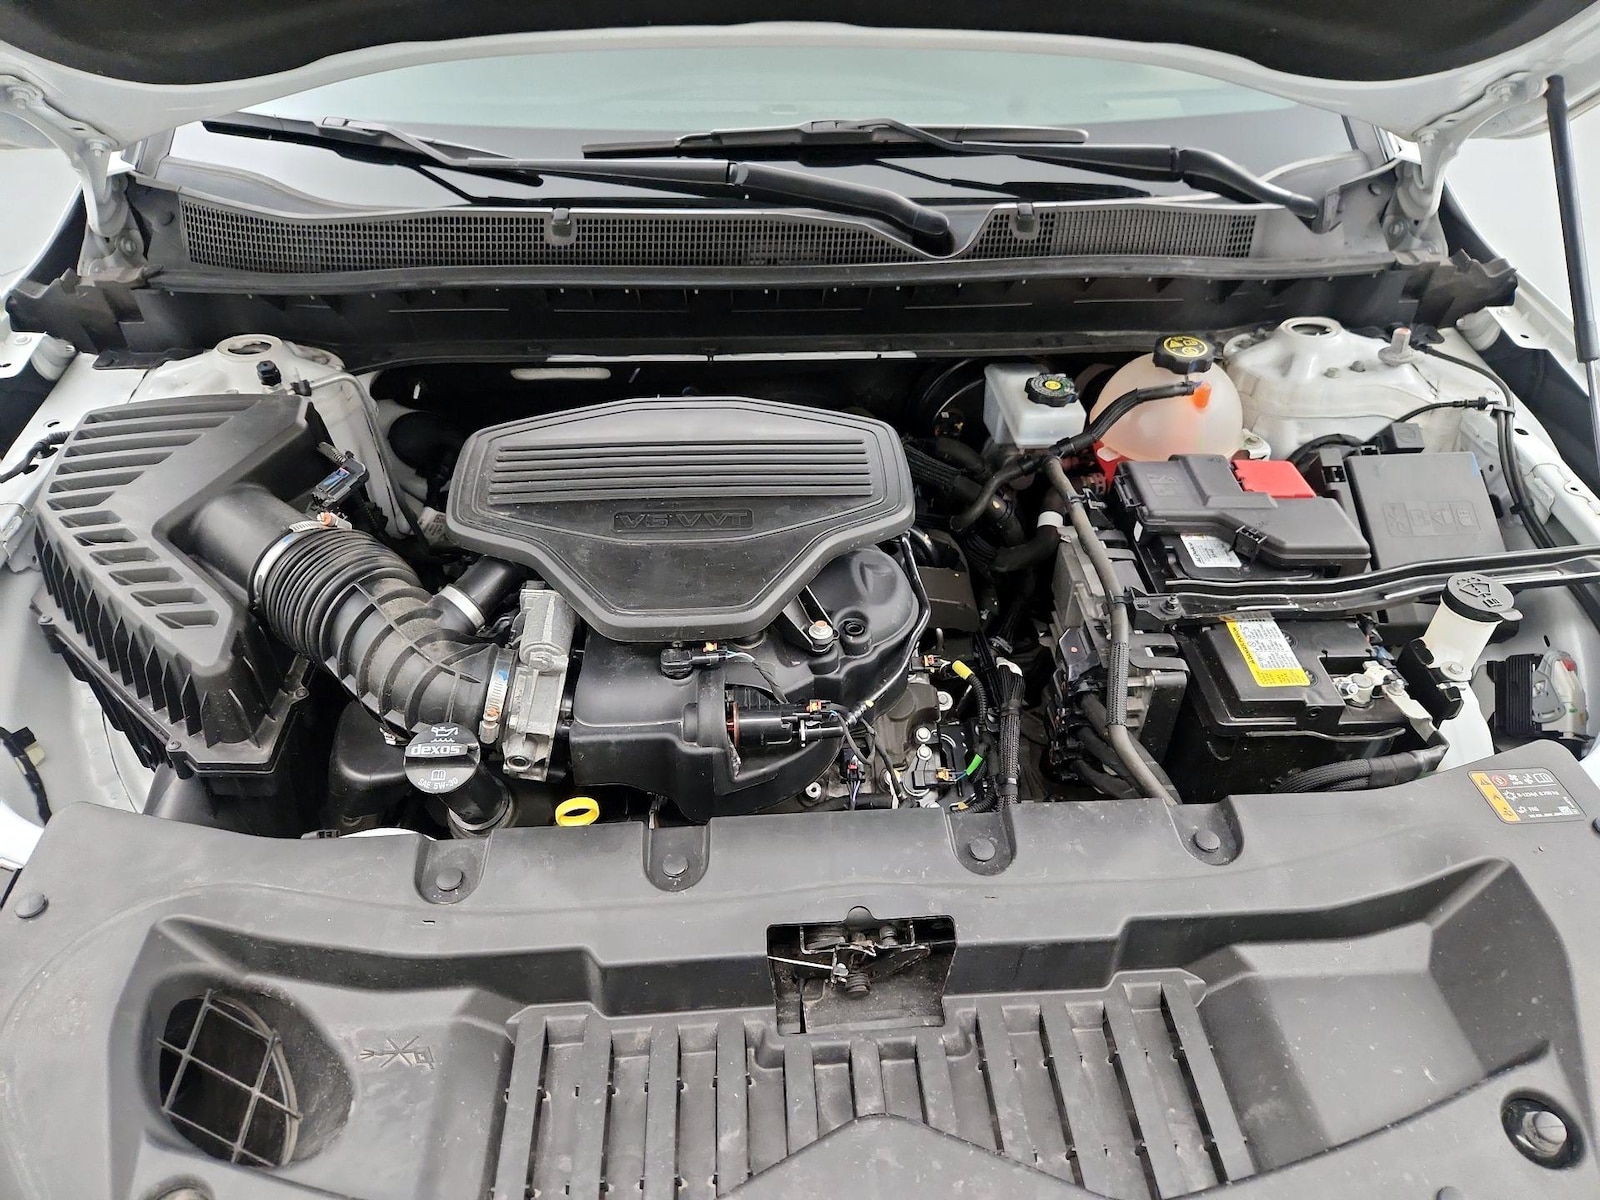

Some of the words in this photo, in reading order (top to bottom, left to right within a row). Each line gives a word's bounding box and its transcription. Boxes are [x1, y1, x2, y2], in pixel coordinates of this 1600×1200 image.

[676, 512, 748, 526] VVT
[411, 744, 462, 755] dexos
[418, 778, 432, 789] SAE
[434, 777, 459, 789] 5W-30
